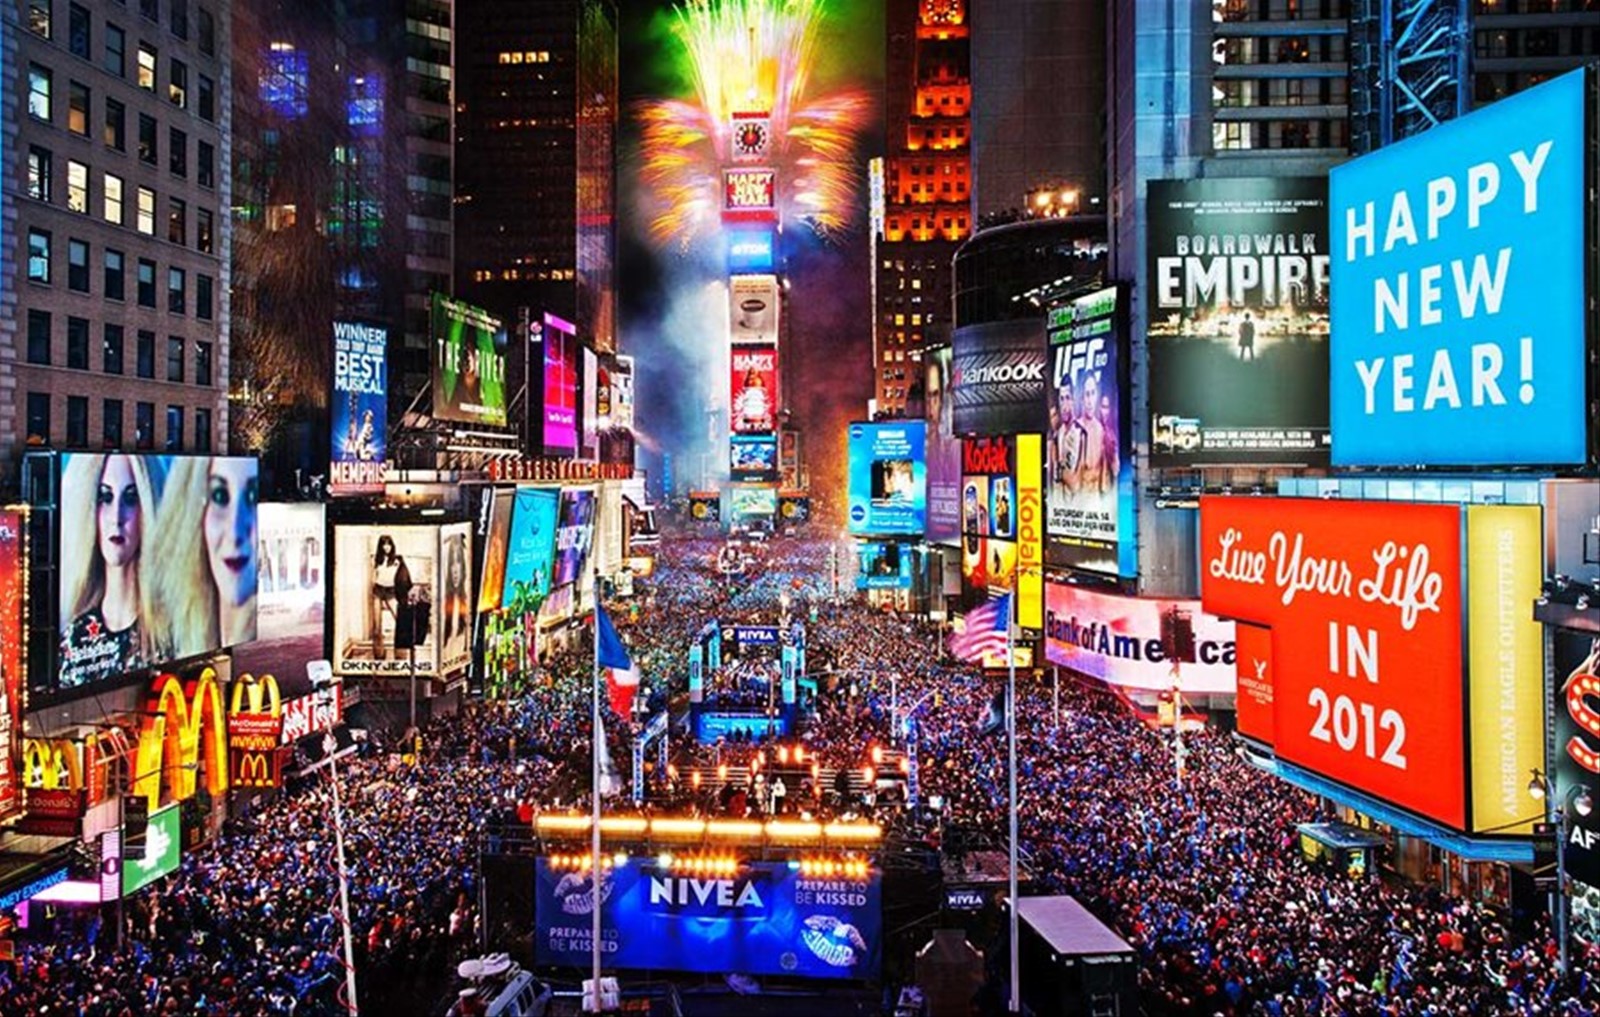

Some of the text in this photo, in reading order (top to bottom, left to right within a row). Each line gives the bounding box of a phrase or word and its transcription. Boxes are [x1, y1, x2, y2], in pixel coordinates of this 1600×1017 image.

[729, 173, 772, 185] HAPPY
[1346, 139, 1554, 262] HAPPY
[1176, 233, 1316, 255] BOARDWALK
[1374, 247, 1512, 334] NEW
[333, 321, 387, 346] WINNER!
[335, 351, 384, 379] BEST
[437, 338, 461, 374] THE
[335, 376, 384, 395] MUSICAL
[1354, 336, 1536, 415] YEAR!
[964, 436, 1010, 474] Kodak
[330, 461, 387, 484] MEMPHIS
[1053, 507, 1084, 519] SATURDAY
[1019, 486, 1039, 577] Kodak
[1210, 527, 1443, 631] Live Your Life
[738, 629, 774, 641] NIVEA
[1047, 610, 1079, 648] Bank
[1081, 621, 1096, 651] of
[341, 660, 382, 671] DKNY
[1328, 620, 1379, 684] IN
[1498, 529, 1519, 818] AMERICAN EAGLE OUTFITTERS
[1308, 686, 1407, 771] 2012
[22, 866, 69, 899] EXCHANGE
[650, 876, 765, 908] NIVEA
[795, 880, 868, 894] PREPARE TO
[795, 892, 867, 907] BE KISSED
[948, 895, 984, 905] NIVEA
